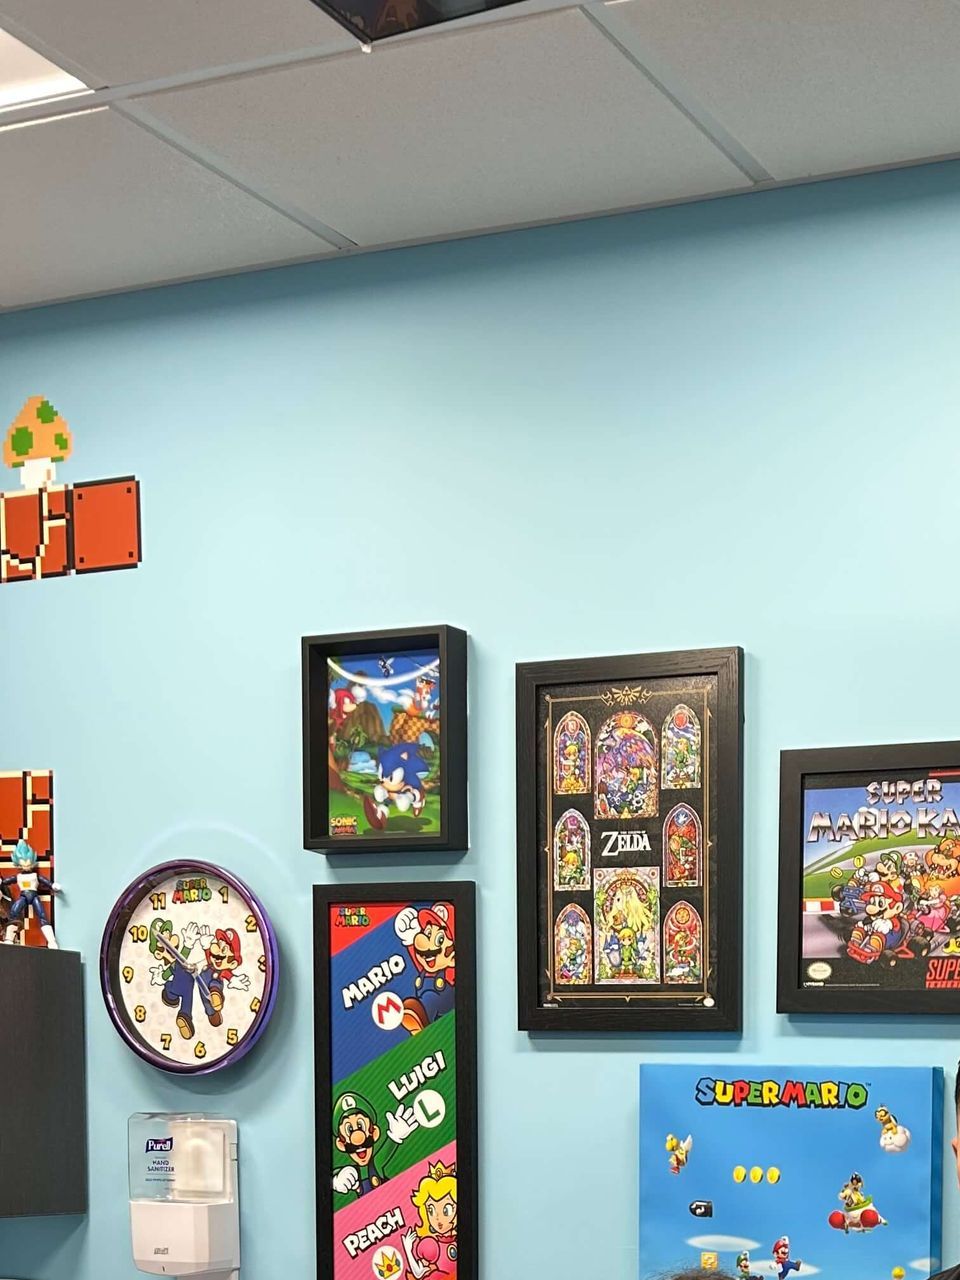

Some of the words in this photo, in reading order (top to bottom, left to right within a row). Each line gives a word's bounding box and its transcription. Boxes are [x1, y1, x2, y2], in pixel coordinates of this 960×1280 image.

[866, 779, 943, 804] SUPER
[330, 816, 358, 826] SONIC
[808, 809, 912, 842] MARIO
[601, 831, 652, 856] ZELDA
[176, 878, 207, 889] SUPER
[150, 892, 166, 910] 11
[172, 888, 212, 903] MARIO
[219, 886, 229, 904] 1
[339, 907, 366, 915] SUPER
[245, 915, 257, 933] 2
[335, 915, 370, 927] MARIO
[129, 925, 148, 943] 10
[122, 966, 133, 983] 9
[342, 953, 407, 1011] MARIO
[134, 1005, 146, 1022] 8
[160, 1033, 172, 1051] 7
[226, 1029, 238, 1046] 5
[194, 1041, 206, 1058] 6
[387, 1050, 448, 1102] LUIGI
[696, 1077, 781, 1107] SUPER
[779, 1079, 868, 1110] MARIO
[149, 1140, 170, 1150] Purell
[342, 1206, 406, 1260] PEACH
